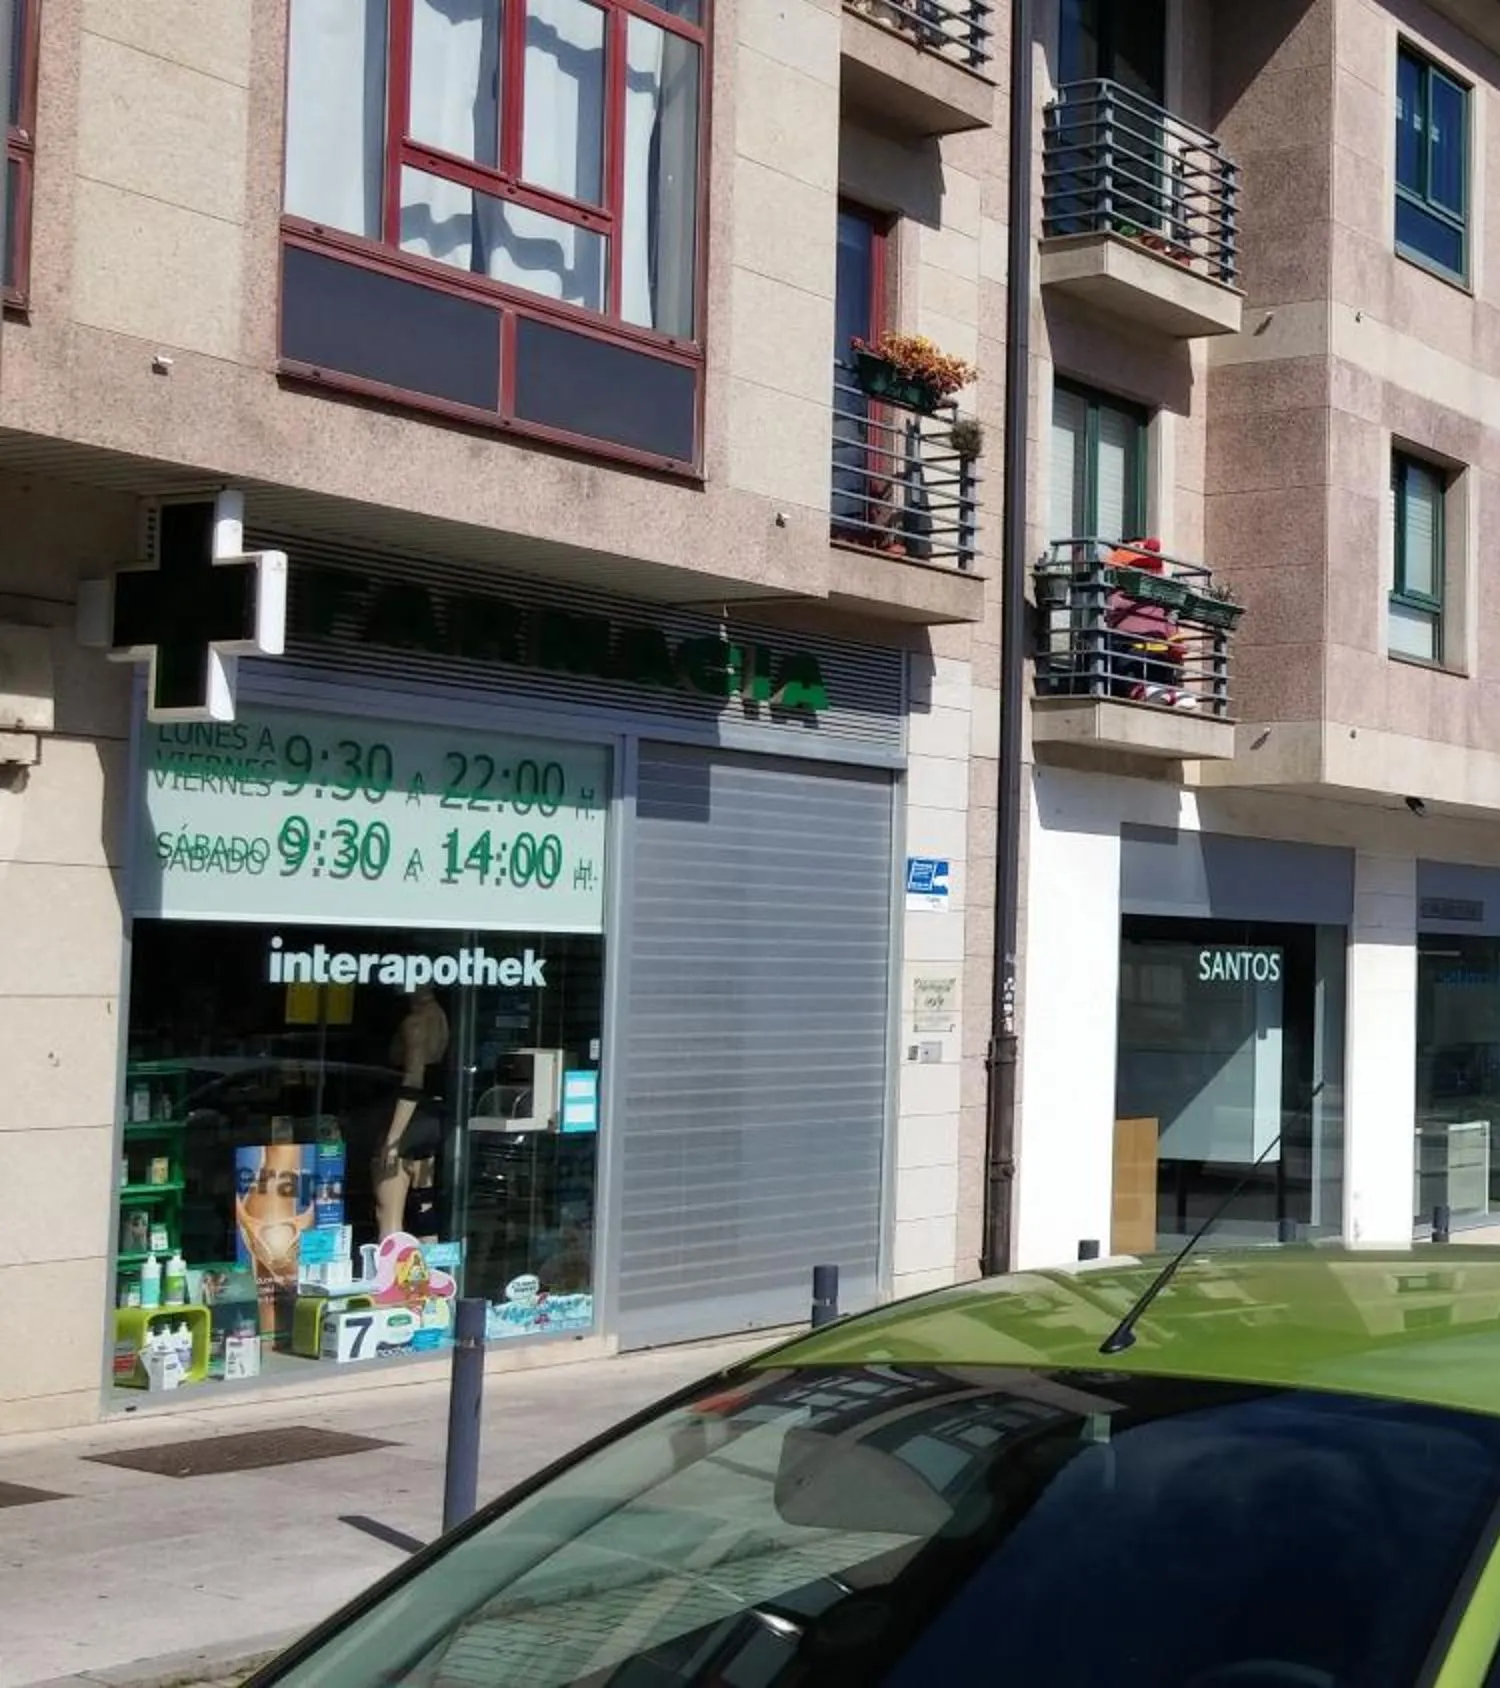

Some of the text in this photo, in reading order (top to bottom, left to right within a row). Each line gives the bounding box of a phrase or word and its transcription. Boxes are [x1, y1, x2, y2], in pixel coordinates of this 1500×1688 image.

[299, 569, 830, 711] FARMACIA
[157, 721, 277, 753] LUNES A
[155, 750, 279, 792] VIERNES
[284, 734, 394, 796] 9:30
[440, 752, 565, 811] 22:00
[155, 823, 271, 866] SÁBADO
[280, 815, 391, 872] 9:30
[406, 848, 424, 876] A
[443, 827, 563, 882] 14:00
[269, 935, 547, 992] interapothek
[1199, 950, 1281, 981] SANTOS
[345, 1316, 374, 1359] 7
